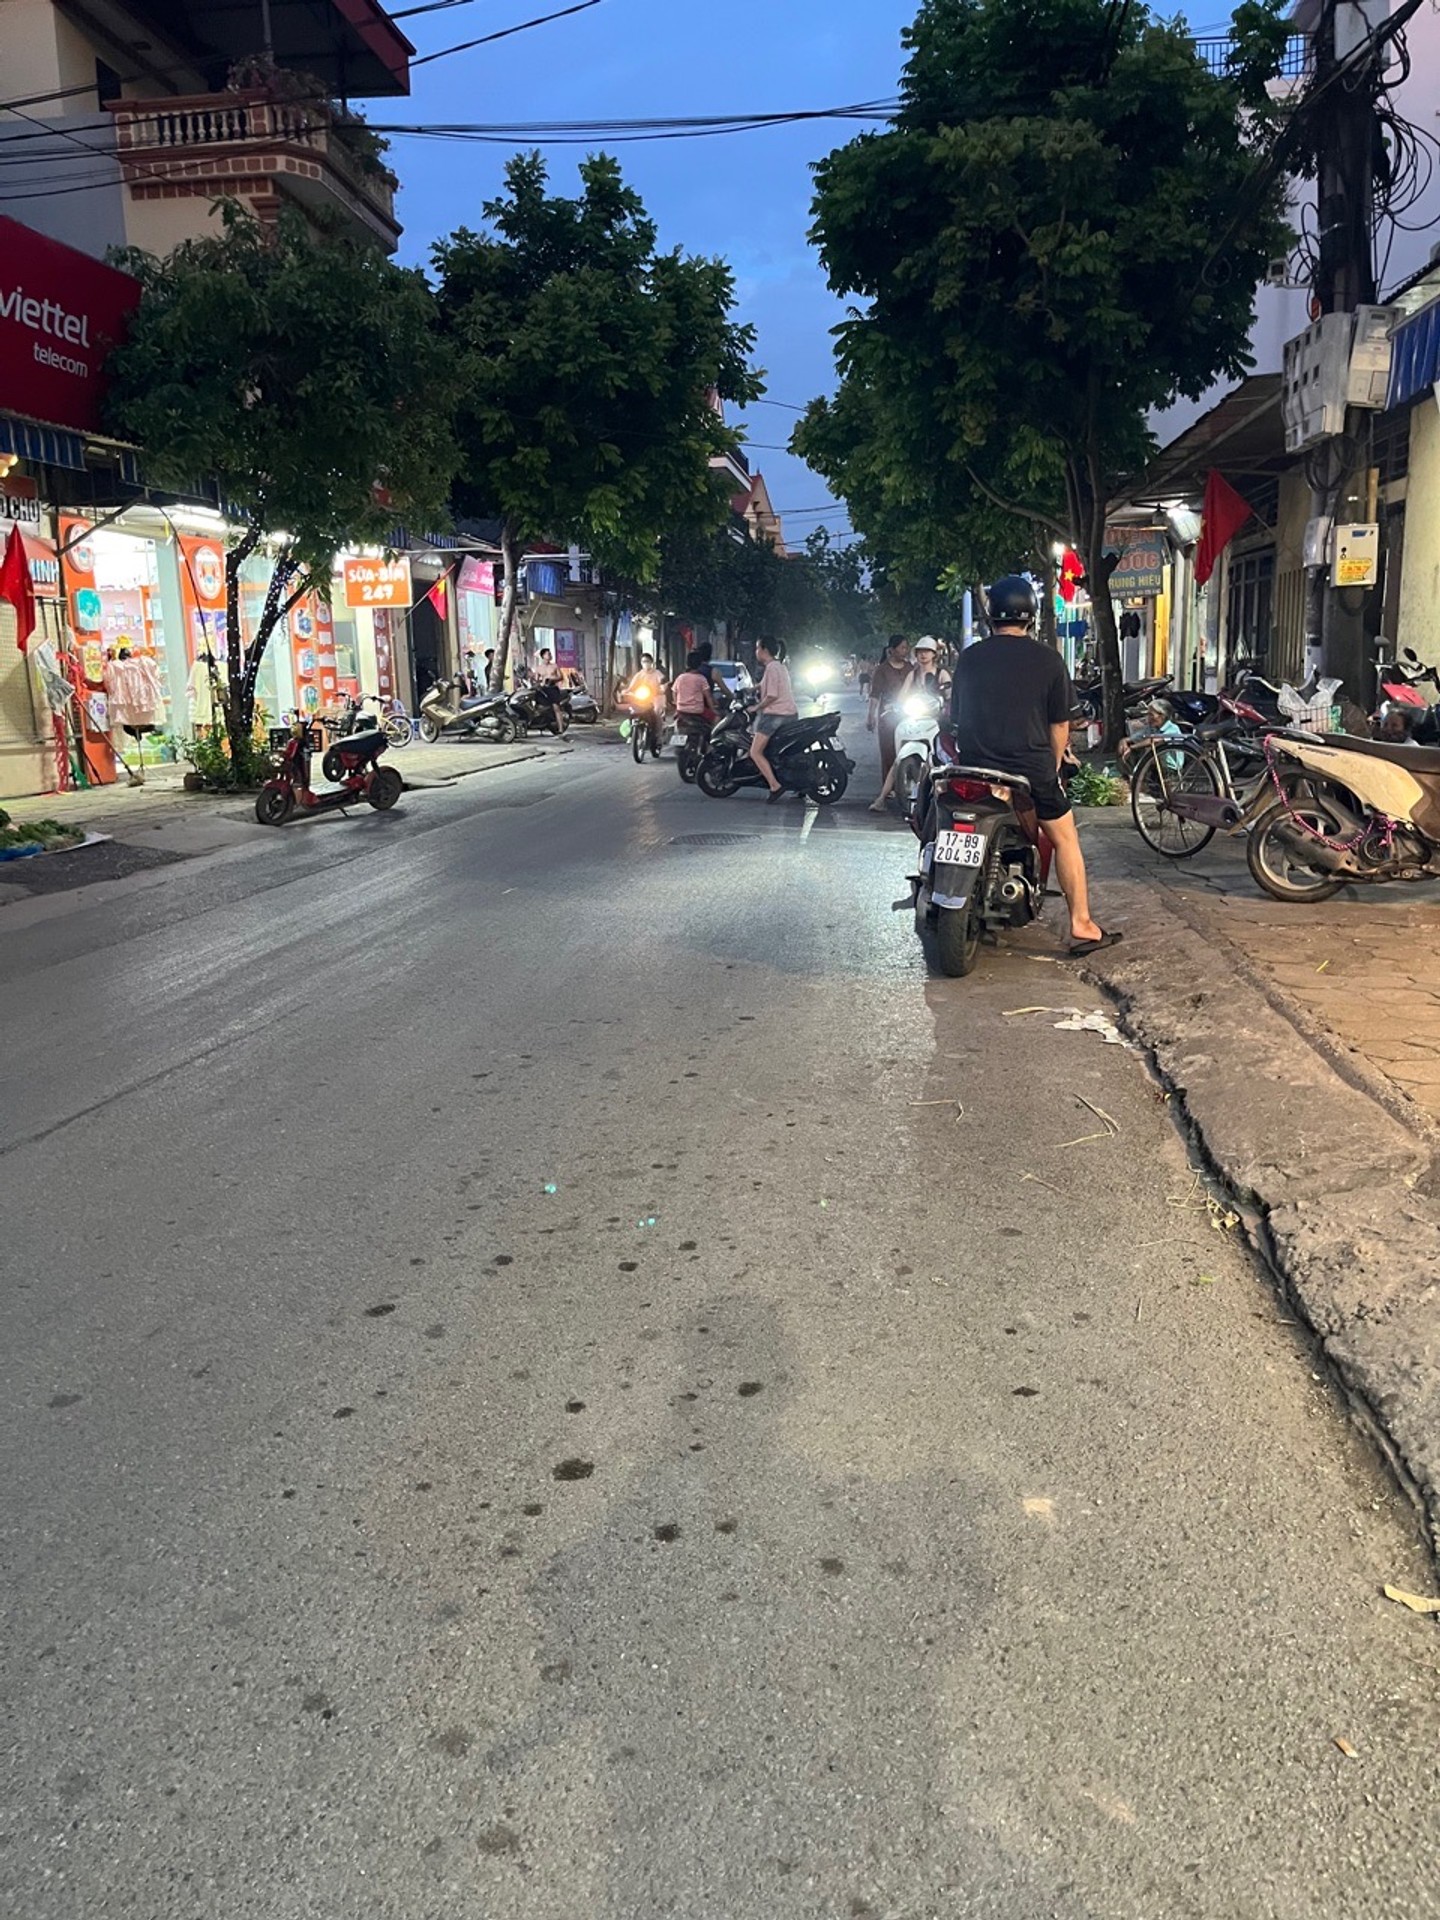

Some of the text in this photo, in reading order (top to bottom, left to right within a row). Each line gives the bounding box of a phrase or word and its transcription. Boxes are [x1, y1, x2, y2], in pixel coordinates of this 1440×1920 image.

[0, 286, 90, 349] viettel
[33, 342, 88, 378] telecom
[362, 584, 394, 602] 247
[946, 832, 979, 849] 17-B9
